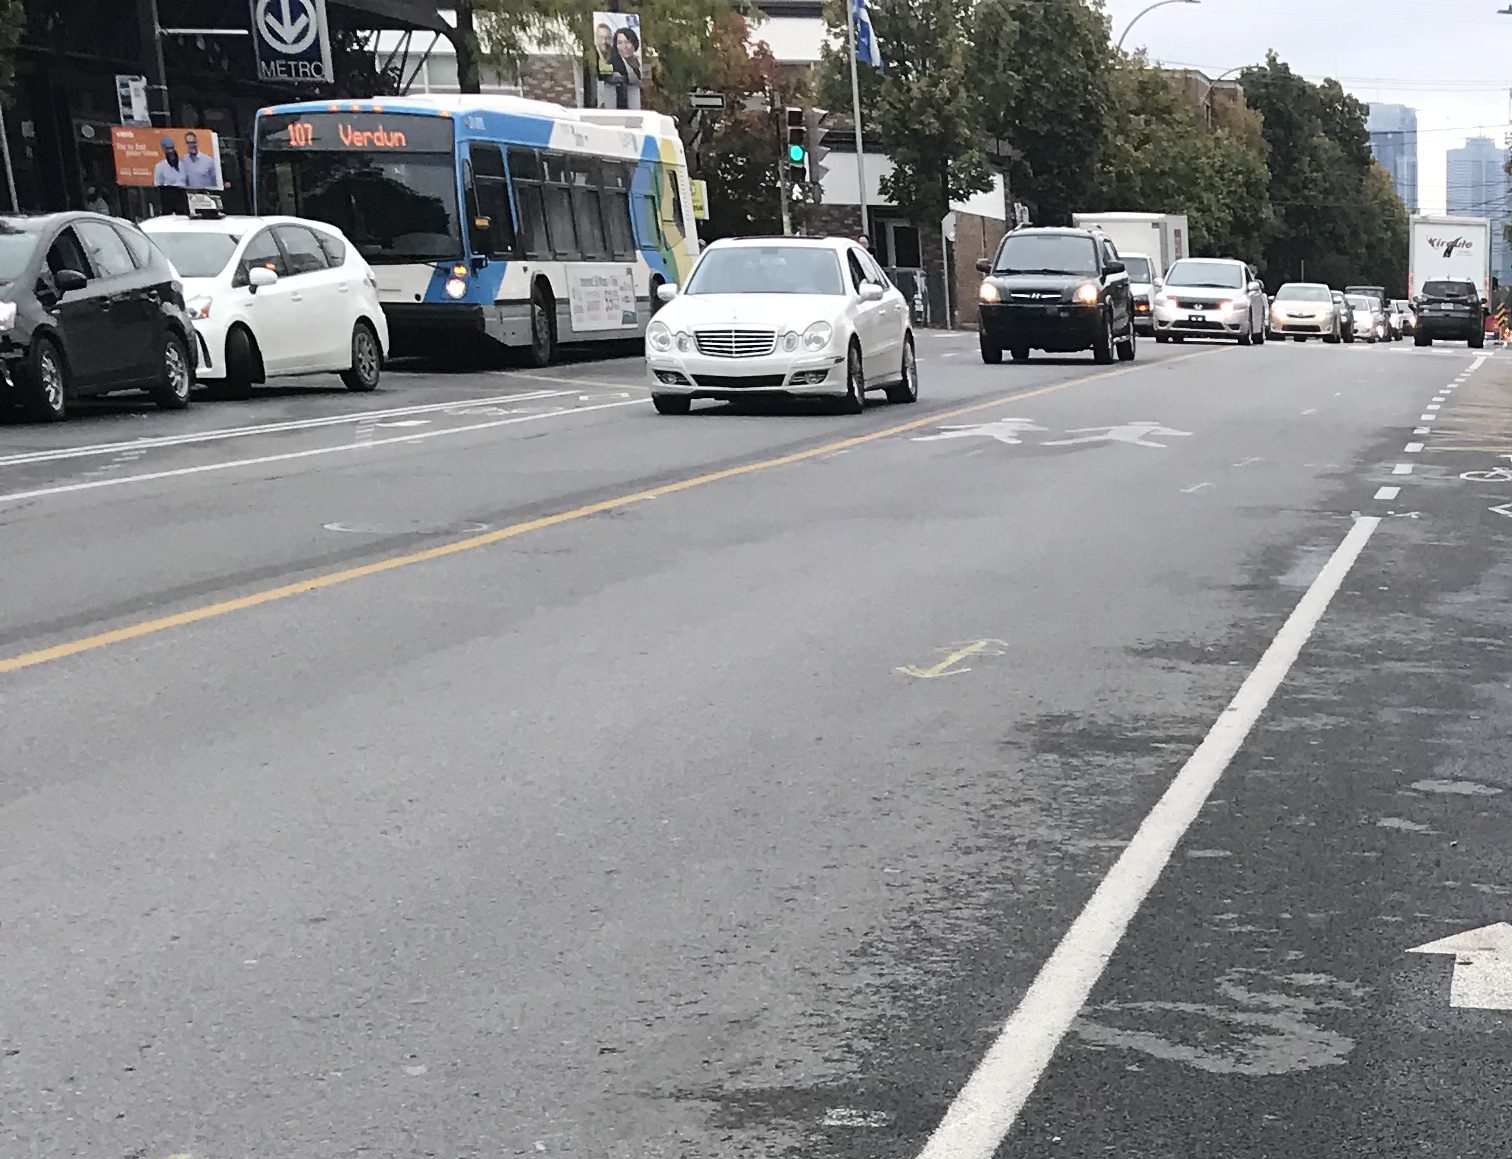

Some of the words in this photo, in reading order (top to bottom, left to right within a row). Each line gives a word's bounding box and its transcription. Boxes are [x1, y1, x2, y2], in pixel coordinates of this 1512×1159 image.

[261, 59, 325, 78] METRO
[287, 122, 313, 147] 107
[338, 123, 407, 147] Verdun
